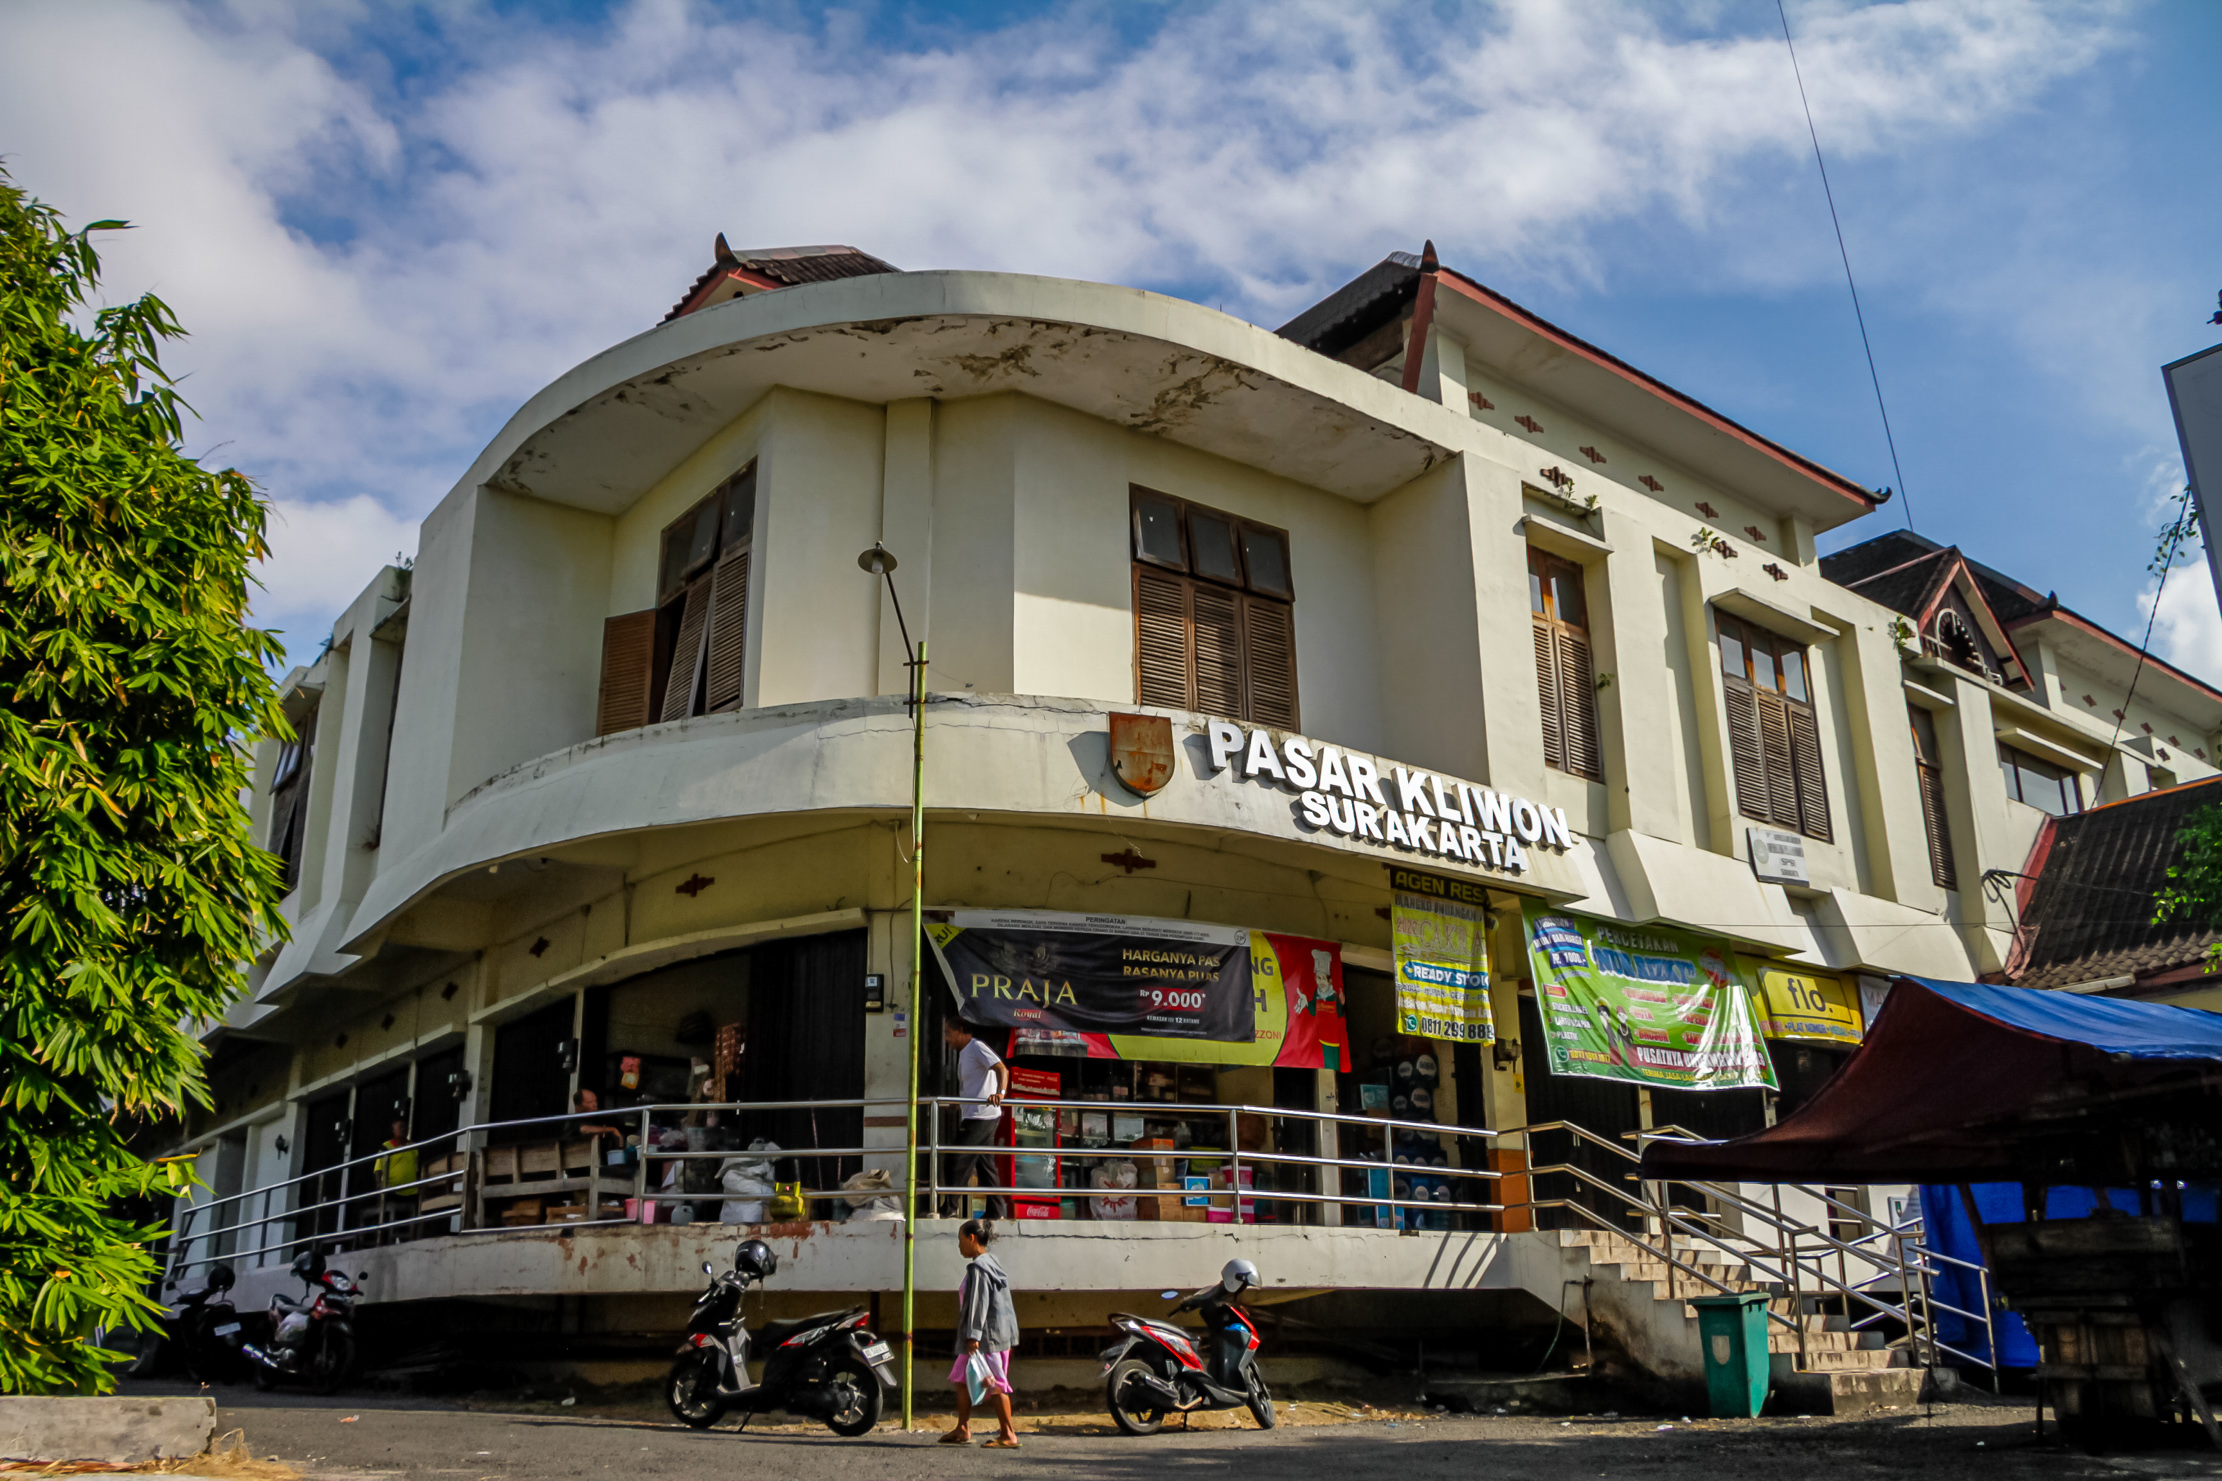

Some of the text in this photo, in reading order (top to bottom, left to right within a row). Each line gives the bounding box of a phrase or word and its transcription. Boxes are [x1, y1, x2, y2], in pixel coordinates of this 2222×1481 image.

[1208, 719, 1575, 850] PASAR KLIWON
[1301, 791, 1527, 872] SURAKARTA
[1395, 871, 1445, 895] AGEN
[1420, 919, 1484, 958] CAKRA
[1596, 926, 1680, 953] PERCETAKAN
[1122, 948, 1220, 967] HARGANYA PAS
[1123, 965, 1186, 980] RASANYA
[1413, 965, 1452, 983] READY
[970, 973, 1078, 1009] PRAJA
[1787, 977, 1834, 1013] flo.
[1013, 1008, 1041, 1019] Royal
[1421, 1017, 1442, 1035] 0811
[1444, 1021, 1465, 1039] 299
[1636, 1046, 1684, 1067] PUSATNYA
